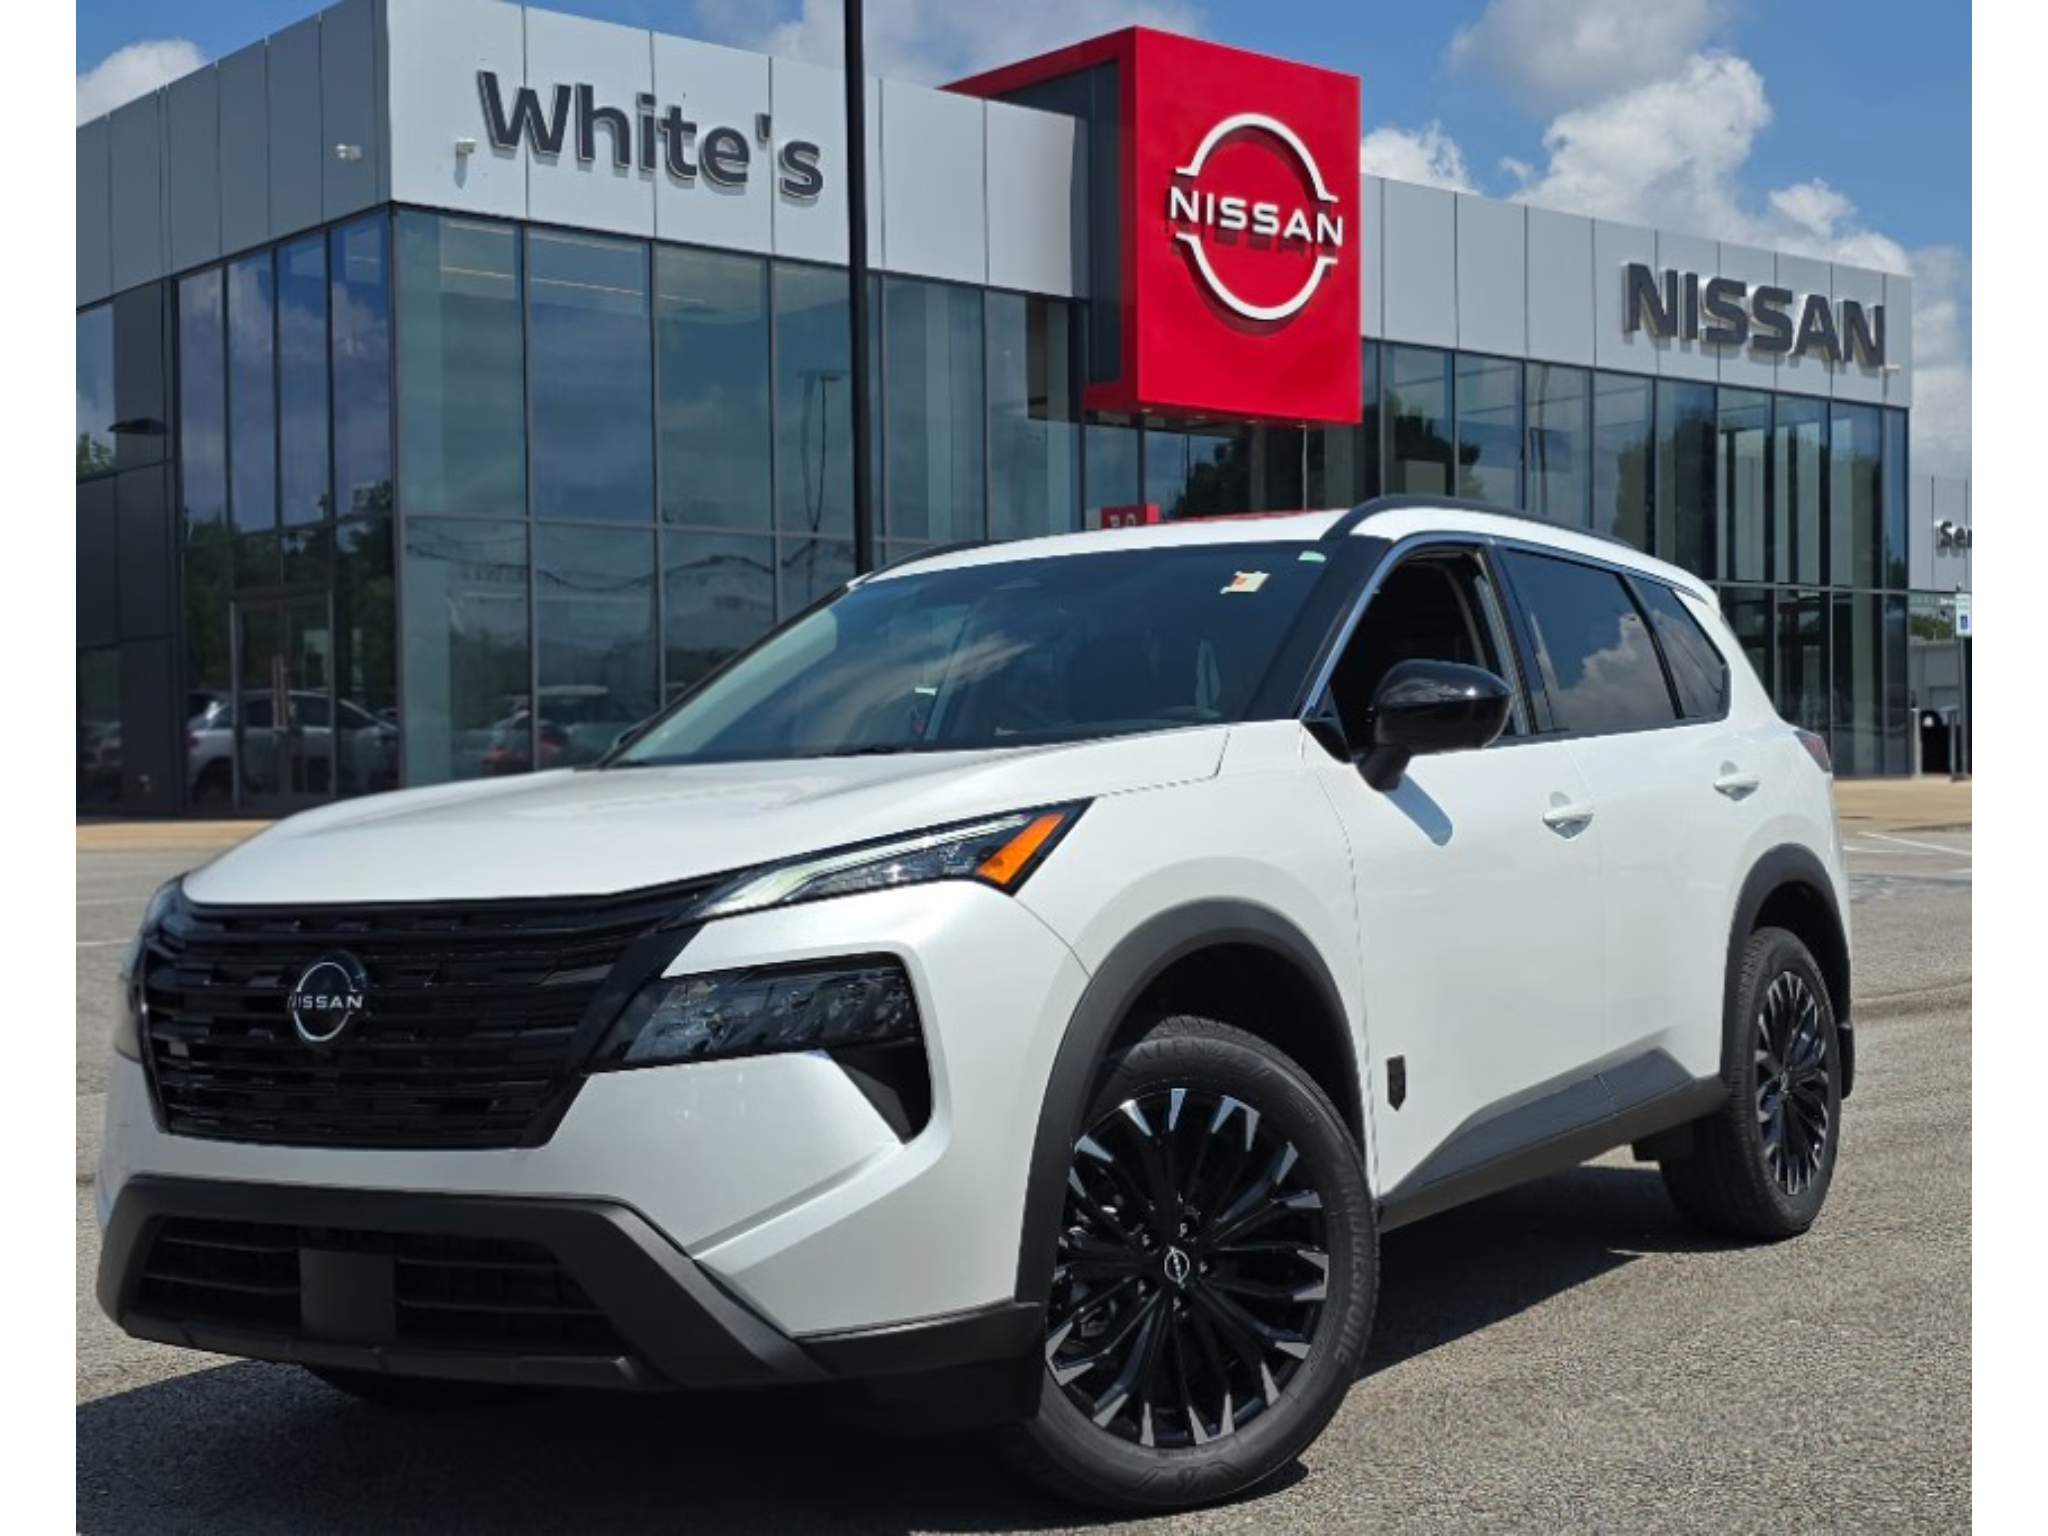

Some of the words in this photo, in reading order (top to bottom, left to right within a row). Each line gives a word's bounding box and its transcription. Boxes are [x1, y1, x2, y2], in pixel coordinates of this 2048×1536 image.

[476, 70, 823, 199] White's
[1170, 186, 1343, 247] NISSAN
[1623, 262, 1886, 367] NISSAN
[286, 995, 363, 1009] NISSAN
